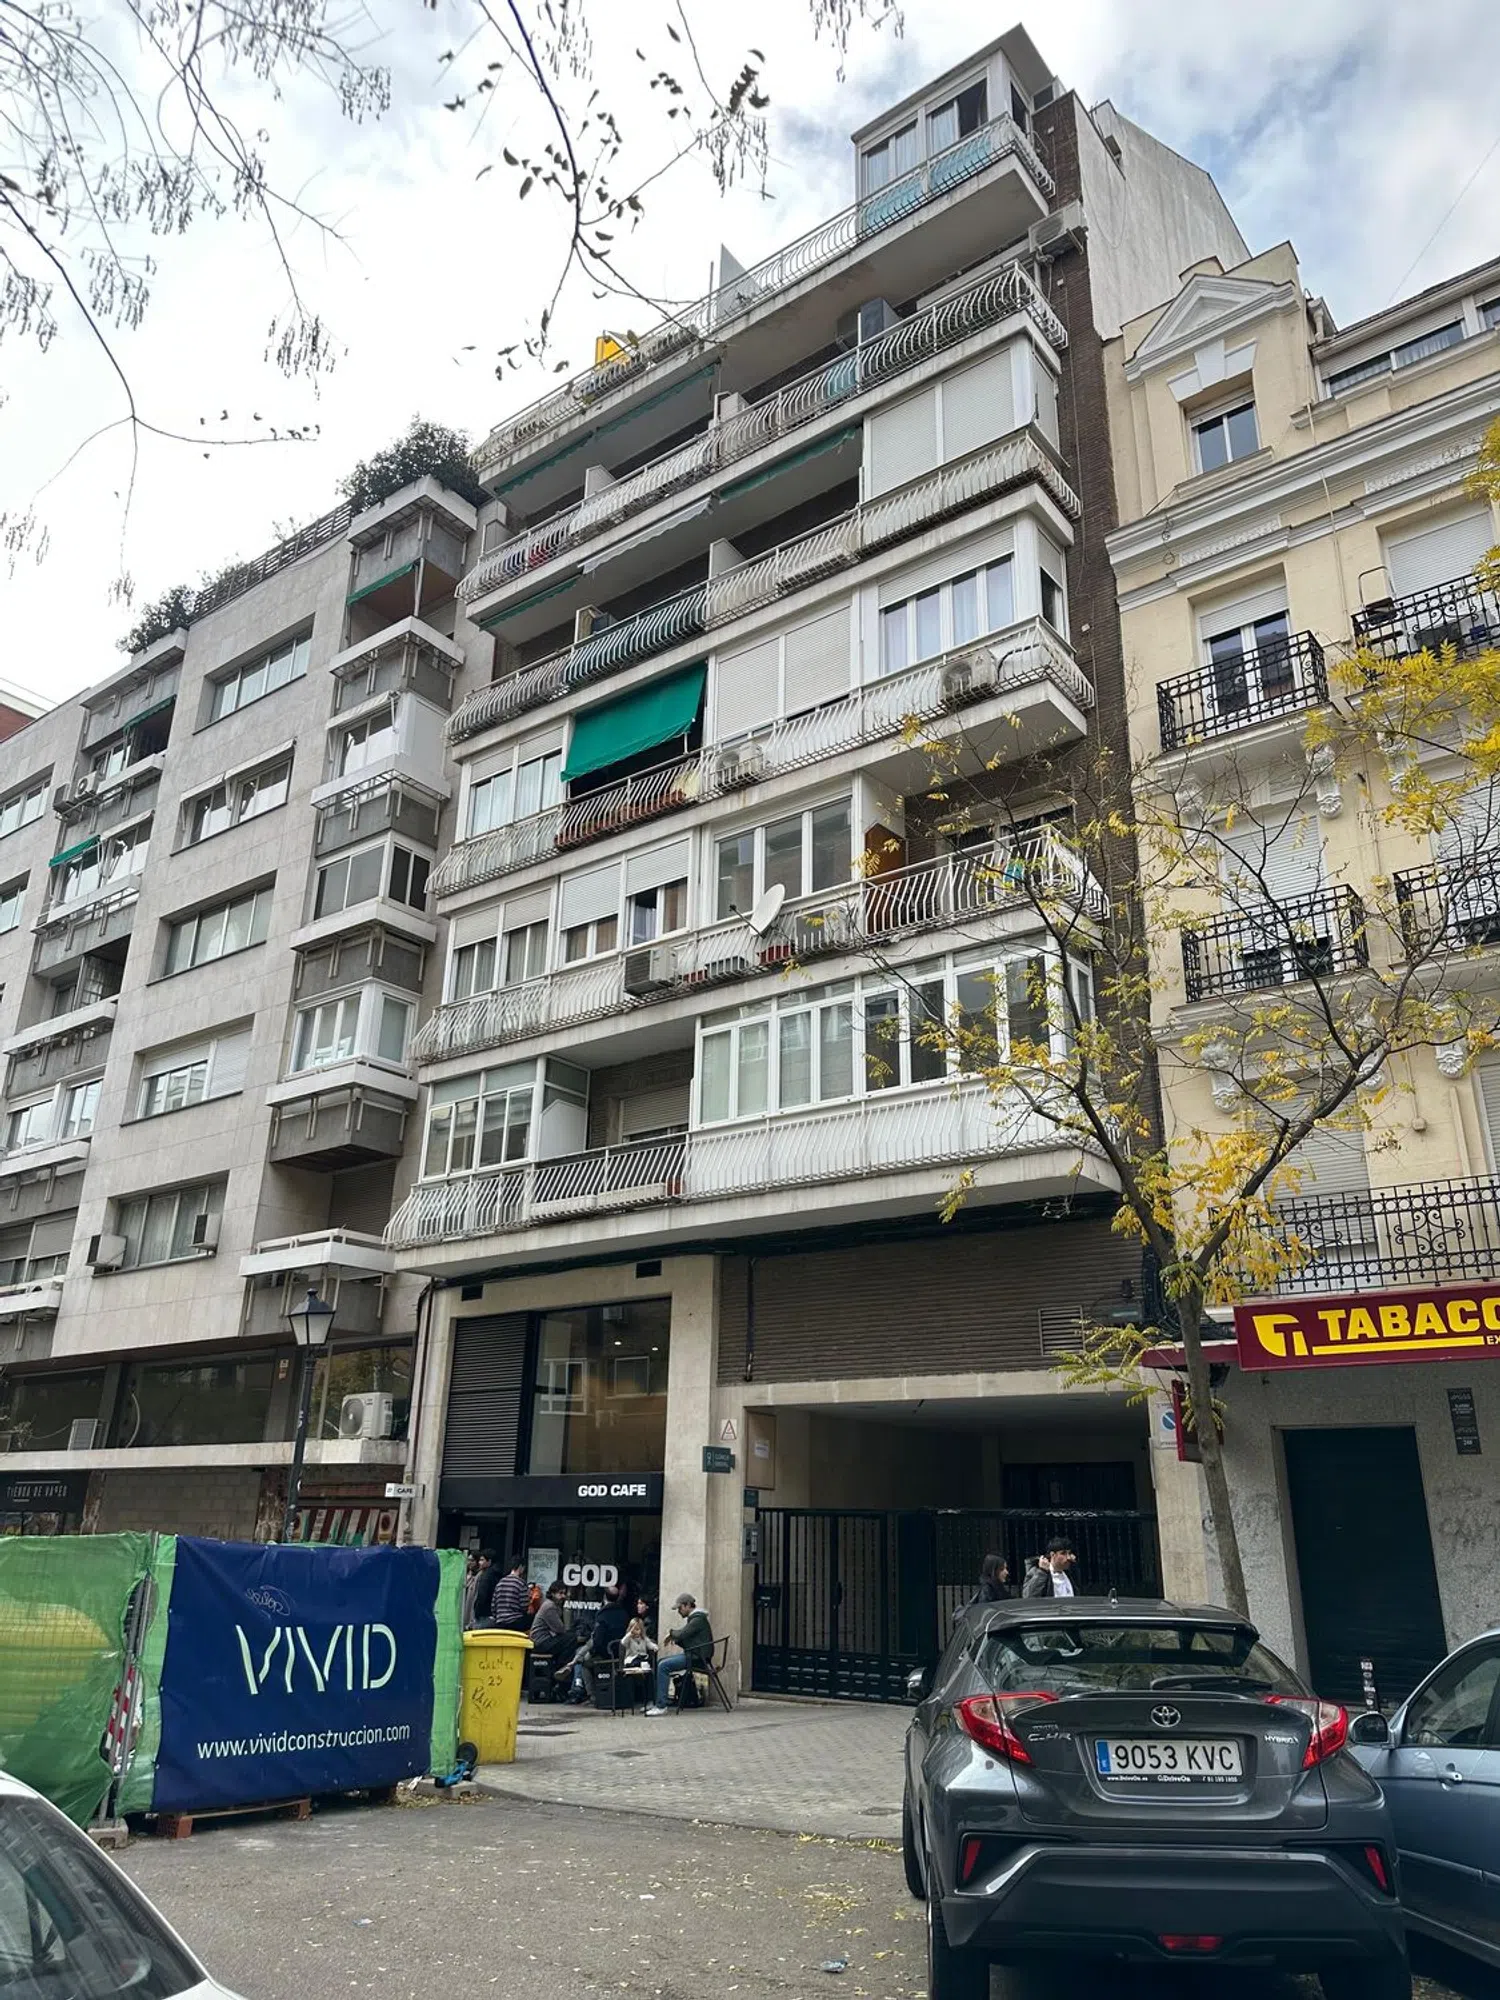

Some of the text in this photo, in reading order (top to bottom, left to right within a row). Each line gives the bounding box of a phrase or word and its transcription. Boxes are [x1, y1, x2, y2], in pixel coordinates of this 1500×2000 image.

[578, 1484, 647, 1497] GOD CAFE
[563, 1563, 619, 1588] GOD
[235, 1624, 397, 1695] VIVID
[197, 1724, 410, 1759] www.vividconstruccion.com
[1114, 1744, 1234, 1770] 9053 KVC
